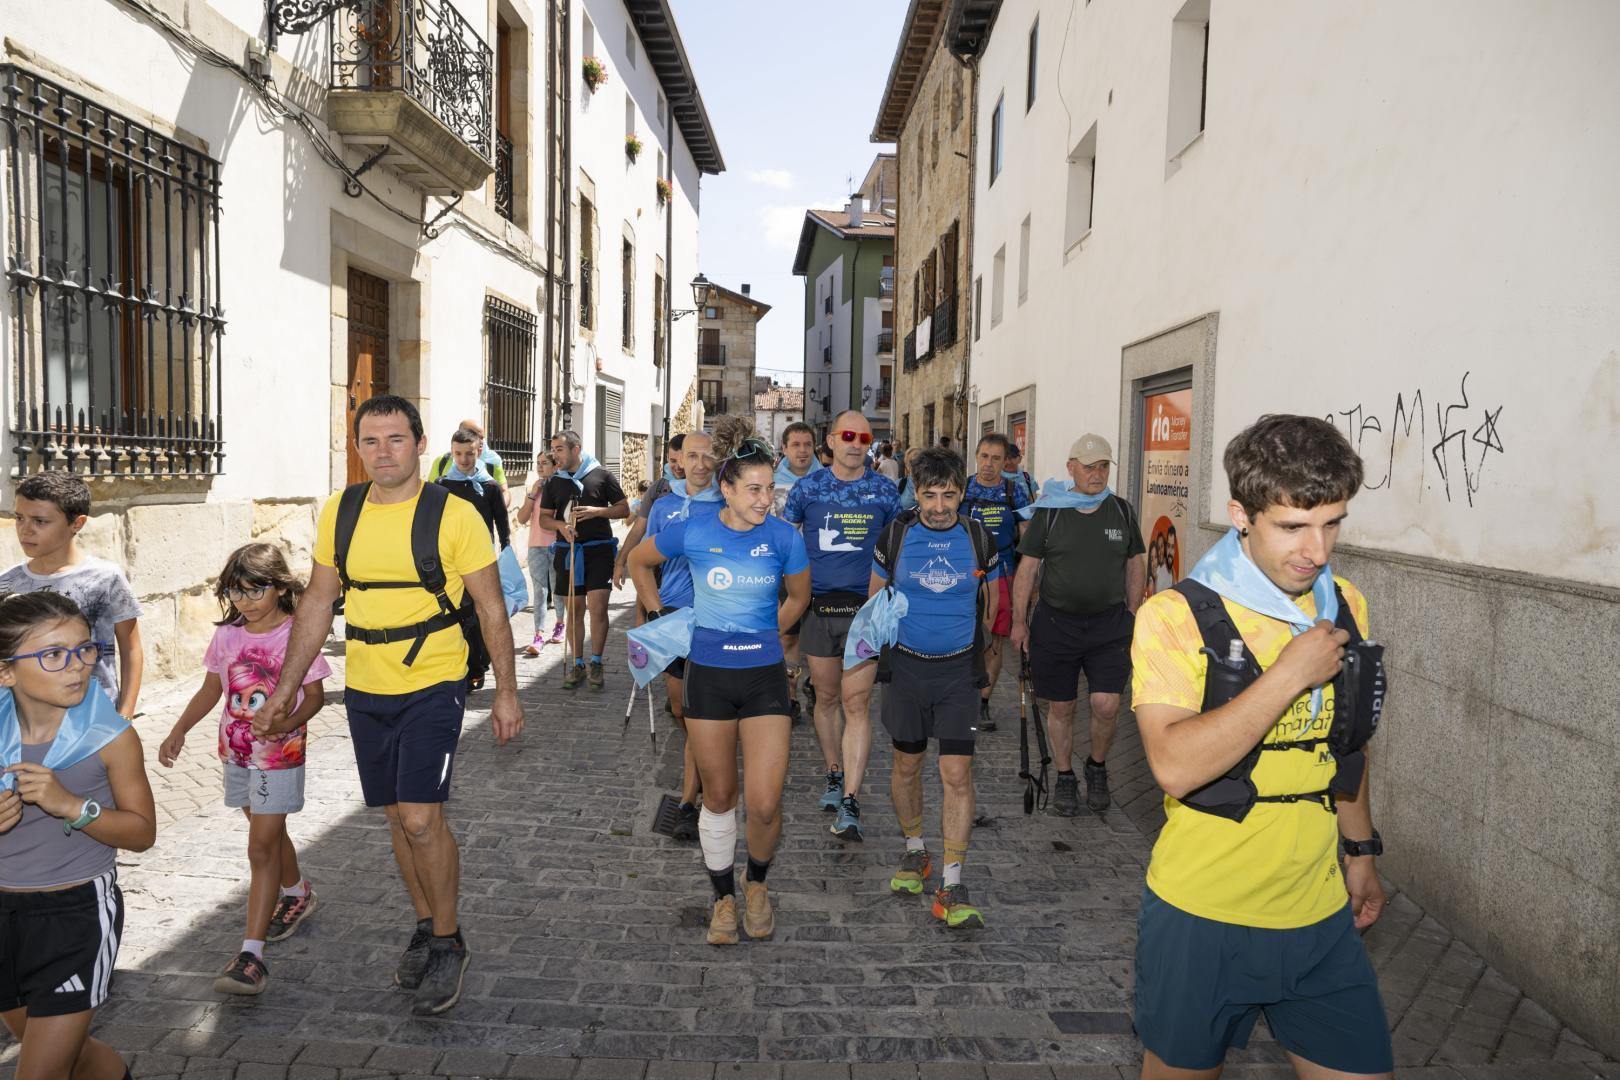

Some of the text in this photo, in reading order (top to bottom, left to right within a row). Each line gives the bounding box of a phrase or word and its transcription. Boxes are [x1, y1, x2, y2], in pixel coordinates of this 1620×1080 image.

[1151, 403, 1170, 441] ria
[1164, 460, 1184, 476] dinero
[1184, 465, 1189, 477] a
[737, 575, 776, 584] RAMOS
